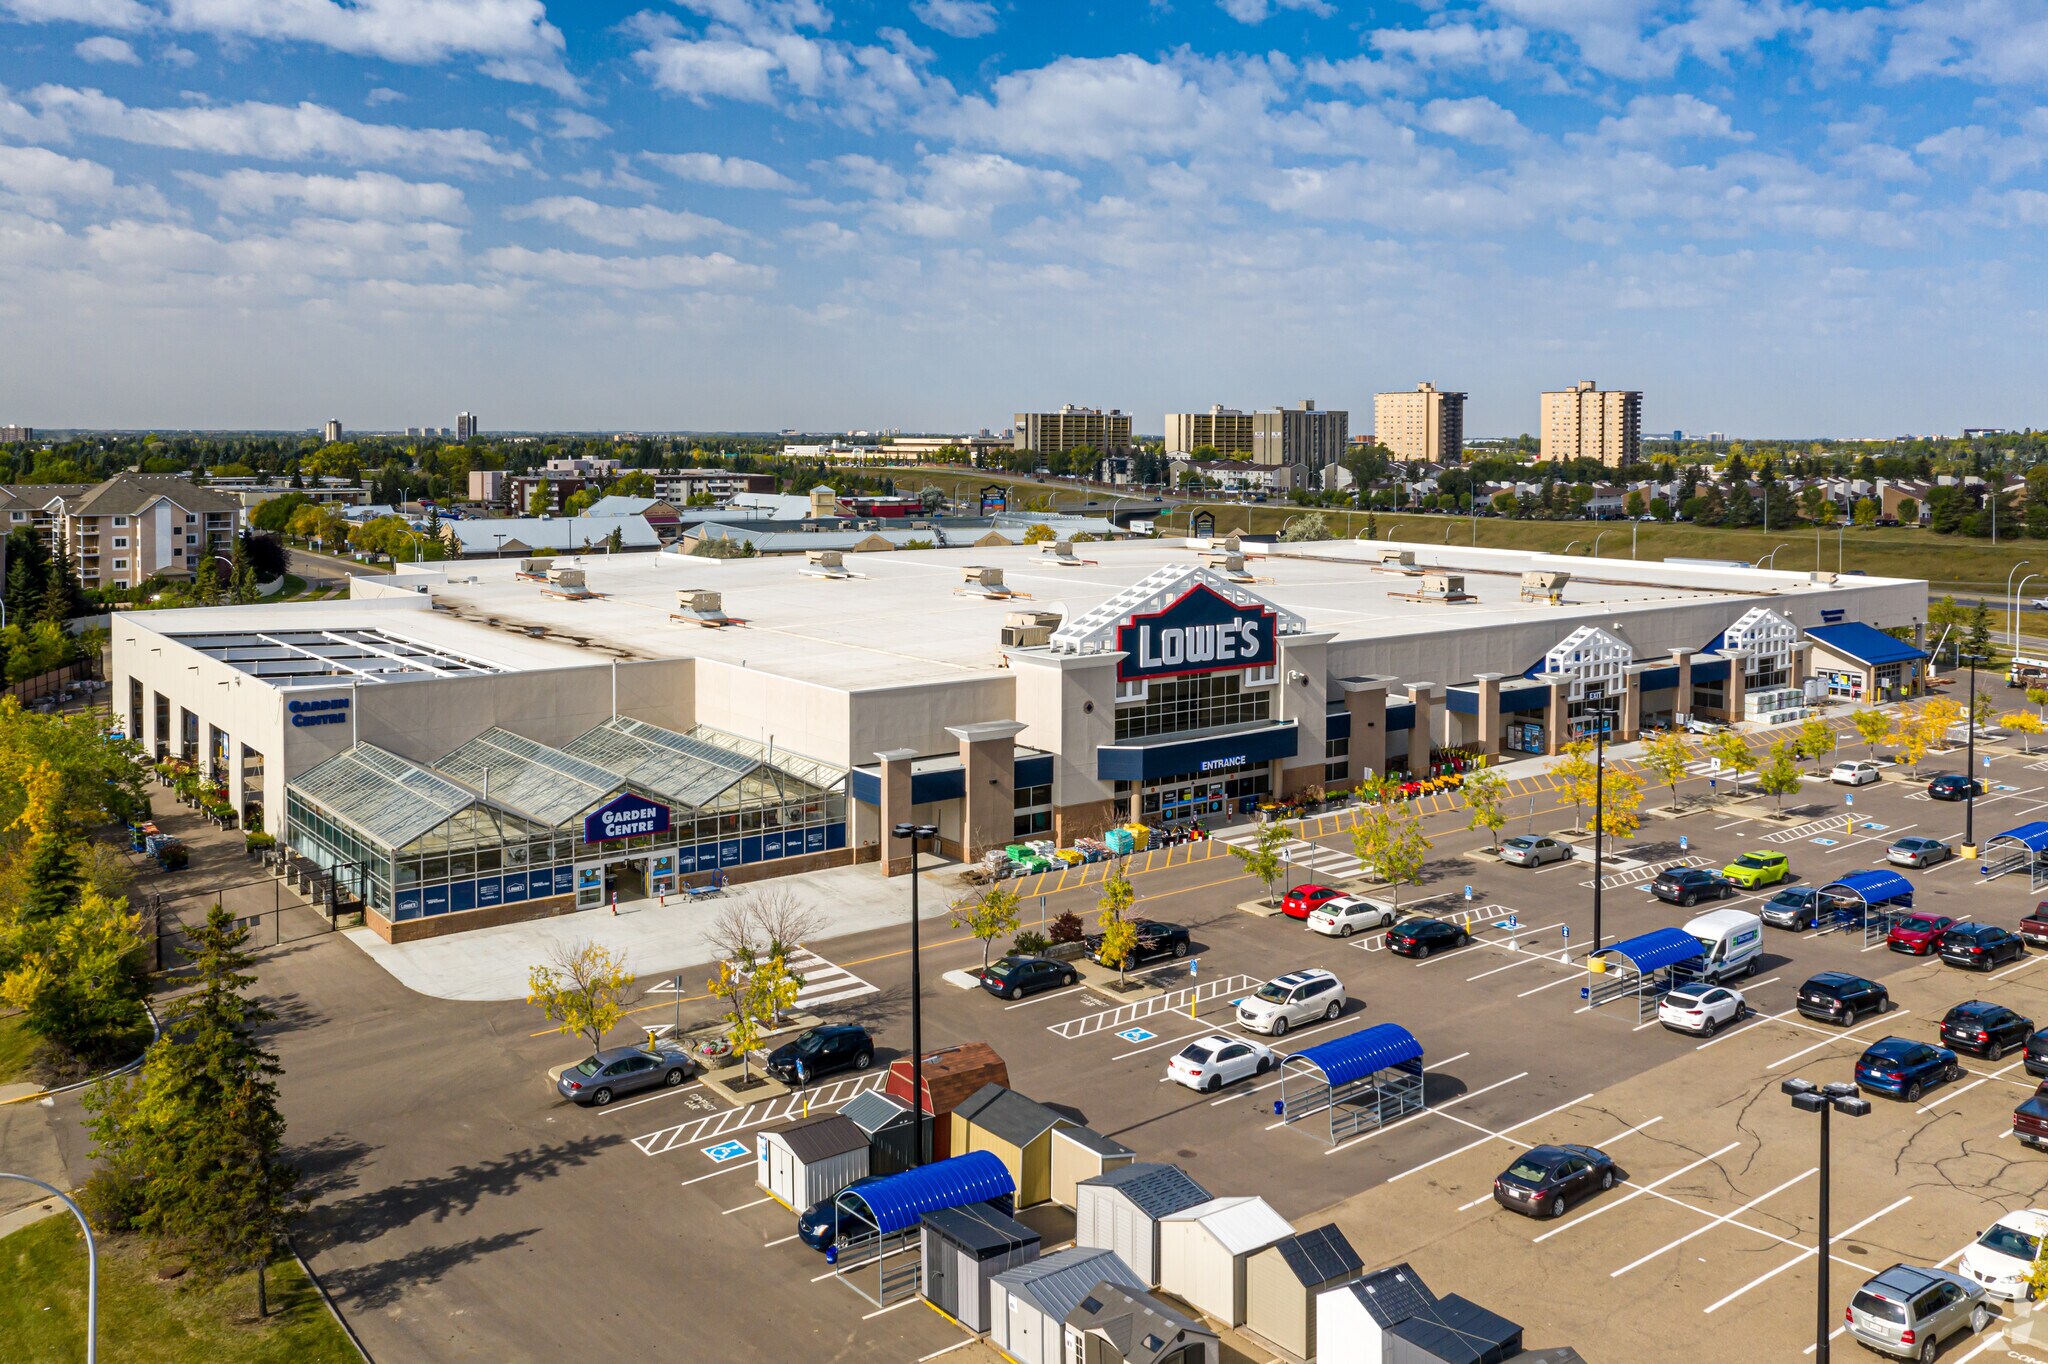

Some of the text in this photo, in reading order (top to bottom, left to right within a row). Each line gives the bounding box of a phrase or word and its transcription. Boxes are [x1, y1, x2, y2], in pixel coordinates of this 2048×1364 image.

[1140, 617, 1260, 668] LOWE'S
[288, 698, 349, 713] GARDEN
[292, 713, 346, 727] CENTRE
[1201, 755, 1246, 771] ENTRANCE
[601, 807, 657, 824] GARDEN
[605, 820, 654, 837] CENTRE
[2007, 1350, 2048, 1364] COM
